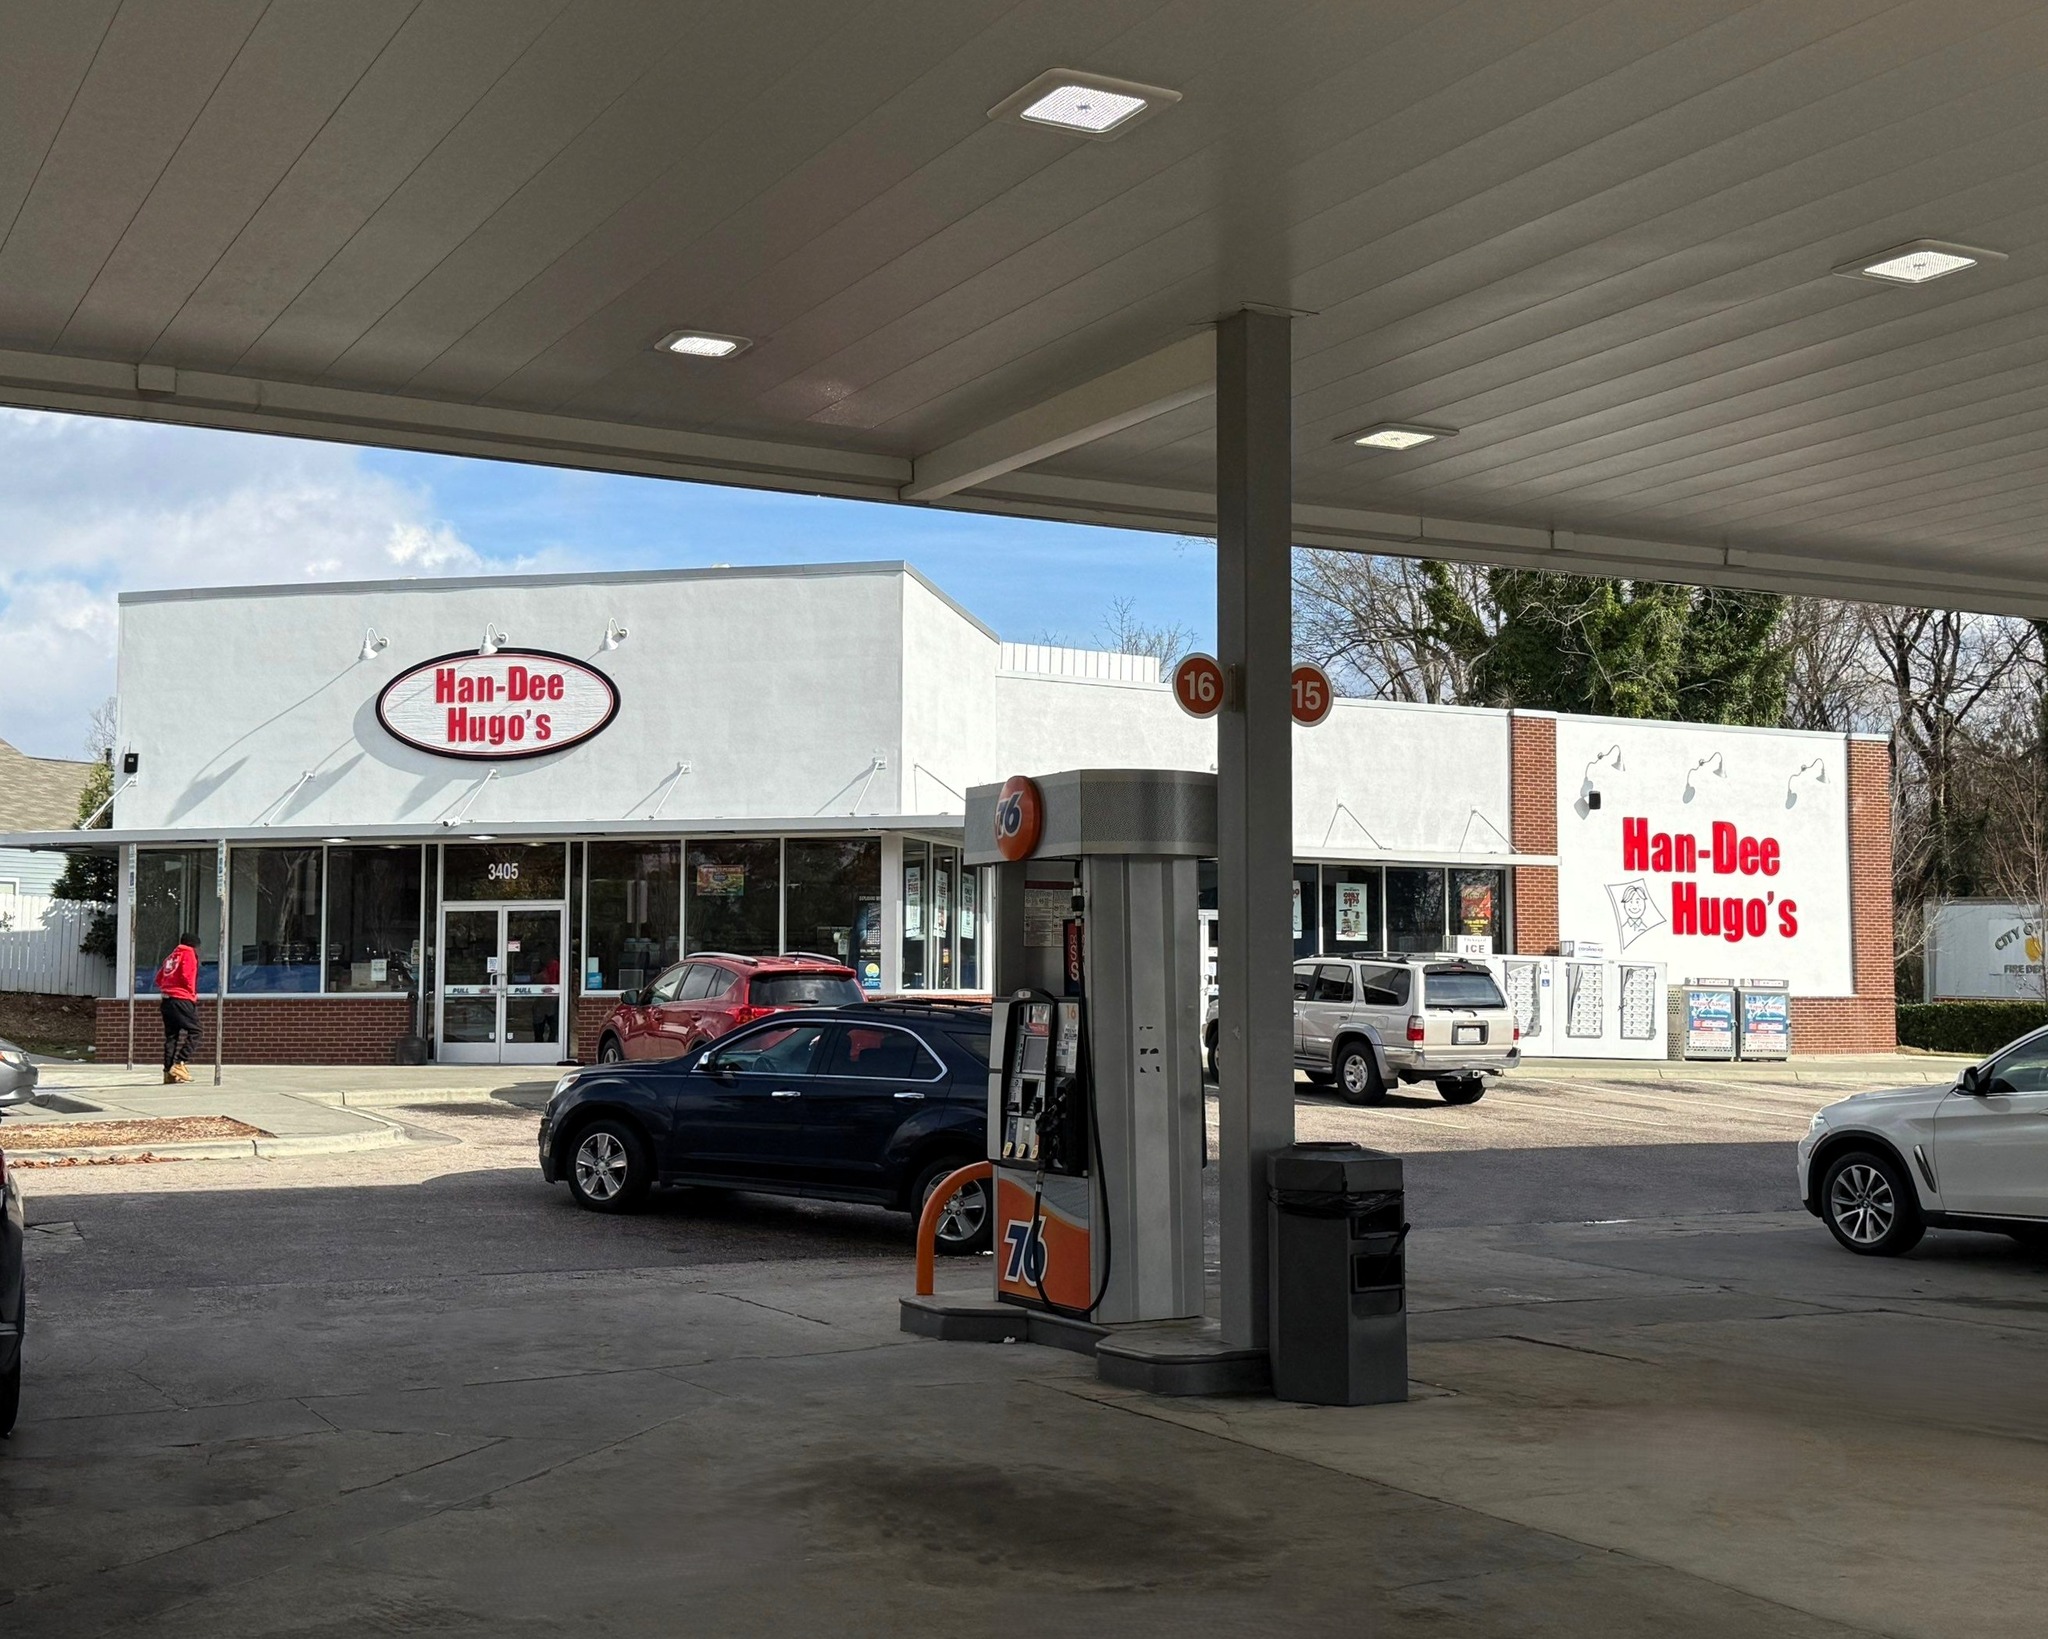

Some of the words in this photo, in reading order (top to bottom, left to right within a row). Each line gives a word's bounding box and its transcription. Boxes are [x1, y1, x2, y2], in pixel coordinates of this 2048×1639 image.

[435, 665, 565, 704] Han-Dee
[1183, 670, 1216, 702] 16
[1291, 680, 1322, 711] 15
[447, 706, 551, 746] Hugo's
[995, 790, 1024, 840] 76
[1622, 816, 1781, 877] Han-Dee
[488, 862, 519, 880] 3405
[1671, 881, 1798, 943] Hugo's
[1465, 944, 1485, 953] ICE
[1994, 926, 2020, 951] CITY
[2003, 964, 2025, 974] FIRE
[1066, 1004, 1077, 1019] 16
[1004, 1215, 1048, 1288] 76
